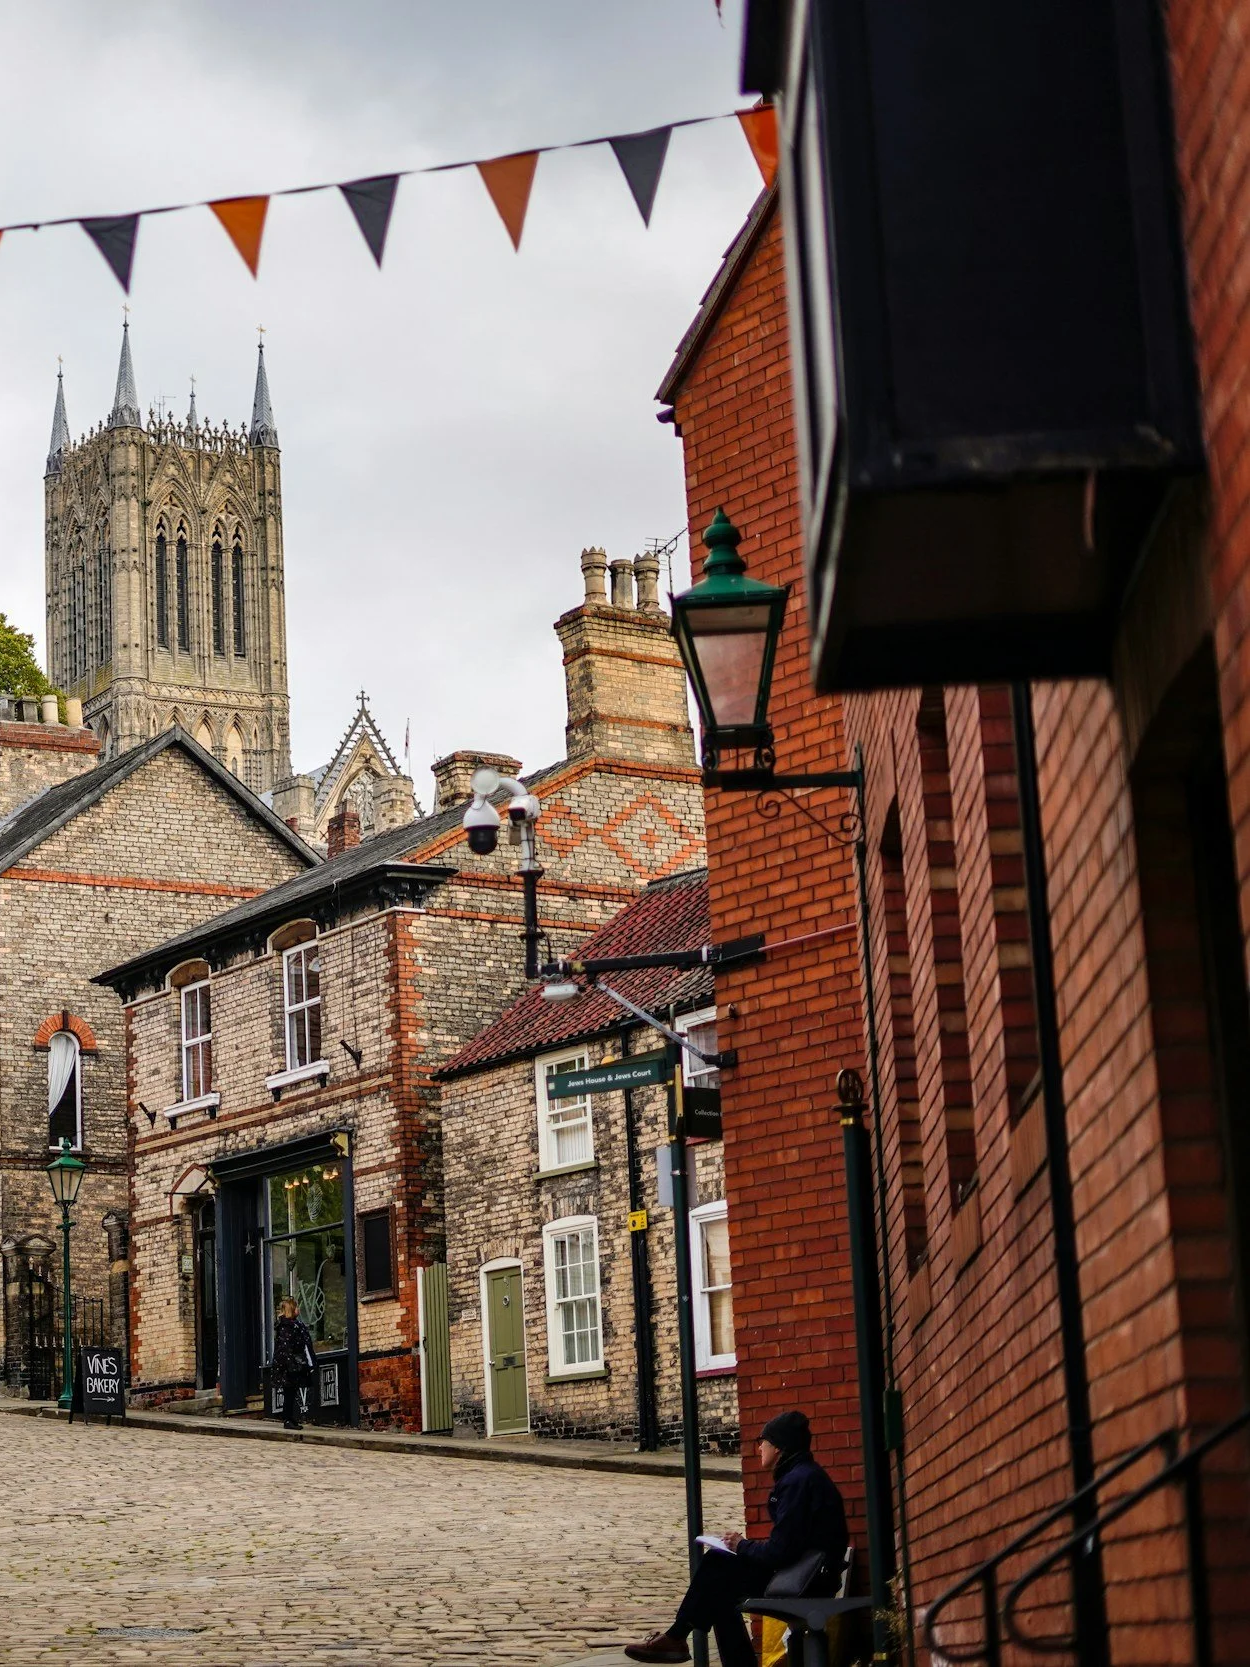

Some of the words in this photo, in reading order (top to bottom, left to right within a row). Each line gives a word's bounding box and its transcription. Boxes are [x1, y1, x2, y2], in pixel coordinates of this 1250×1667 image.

[567, 1079, 584, 1088] Jews
[585, 1076, 606, 1085] House
[607, 1074, 613, 1082] &
[614, 1072, 631, 1081] Jews
[632, 1068, 652, 1078] Court
[694, 1109, 719, 1117] Collection
[86, 1376, 121, 1394] BAKERY
